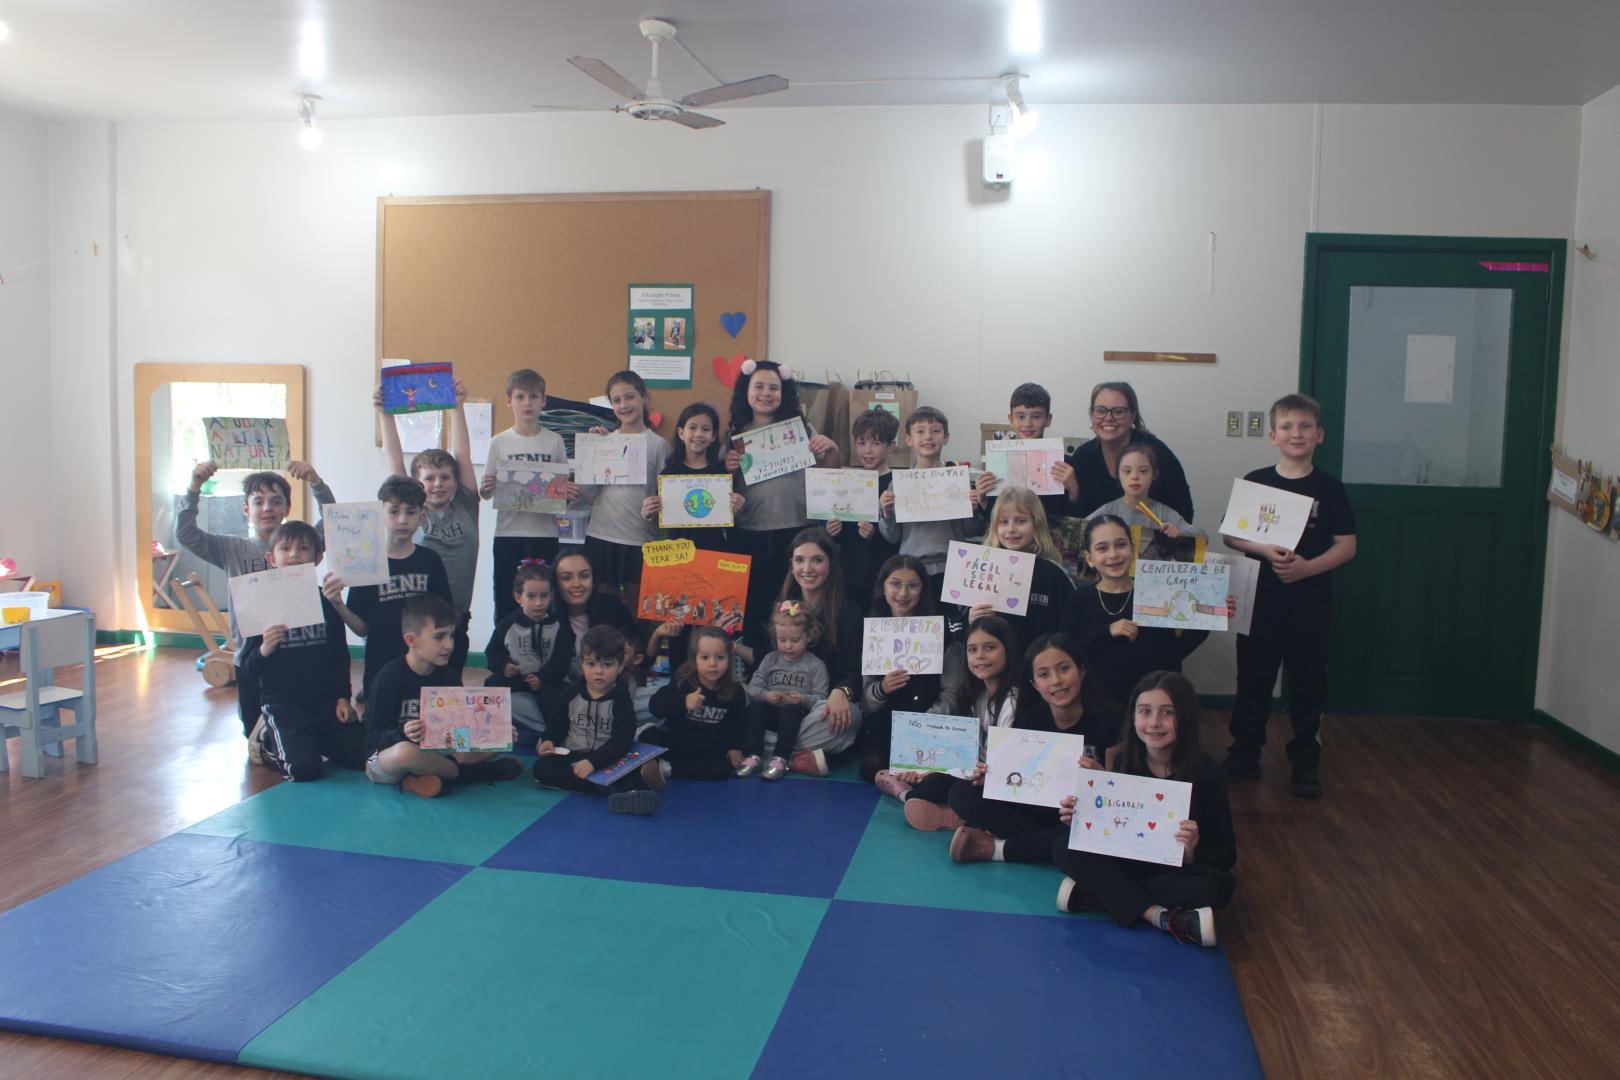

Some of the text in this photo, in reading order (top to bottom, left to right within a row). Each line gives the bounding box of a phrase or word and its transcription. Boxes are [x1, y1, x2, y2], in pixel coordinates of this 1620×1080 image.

[645, 541, 690, 553] THANK YOU
[650, 554, 671, 564] YEAR
[965, 558, 1000, 575] FÁCIL
[971, 570, 994, 582] SER
[963, 578, 999, 593] LEGAL
